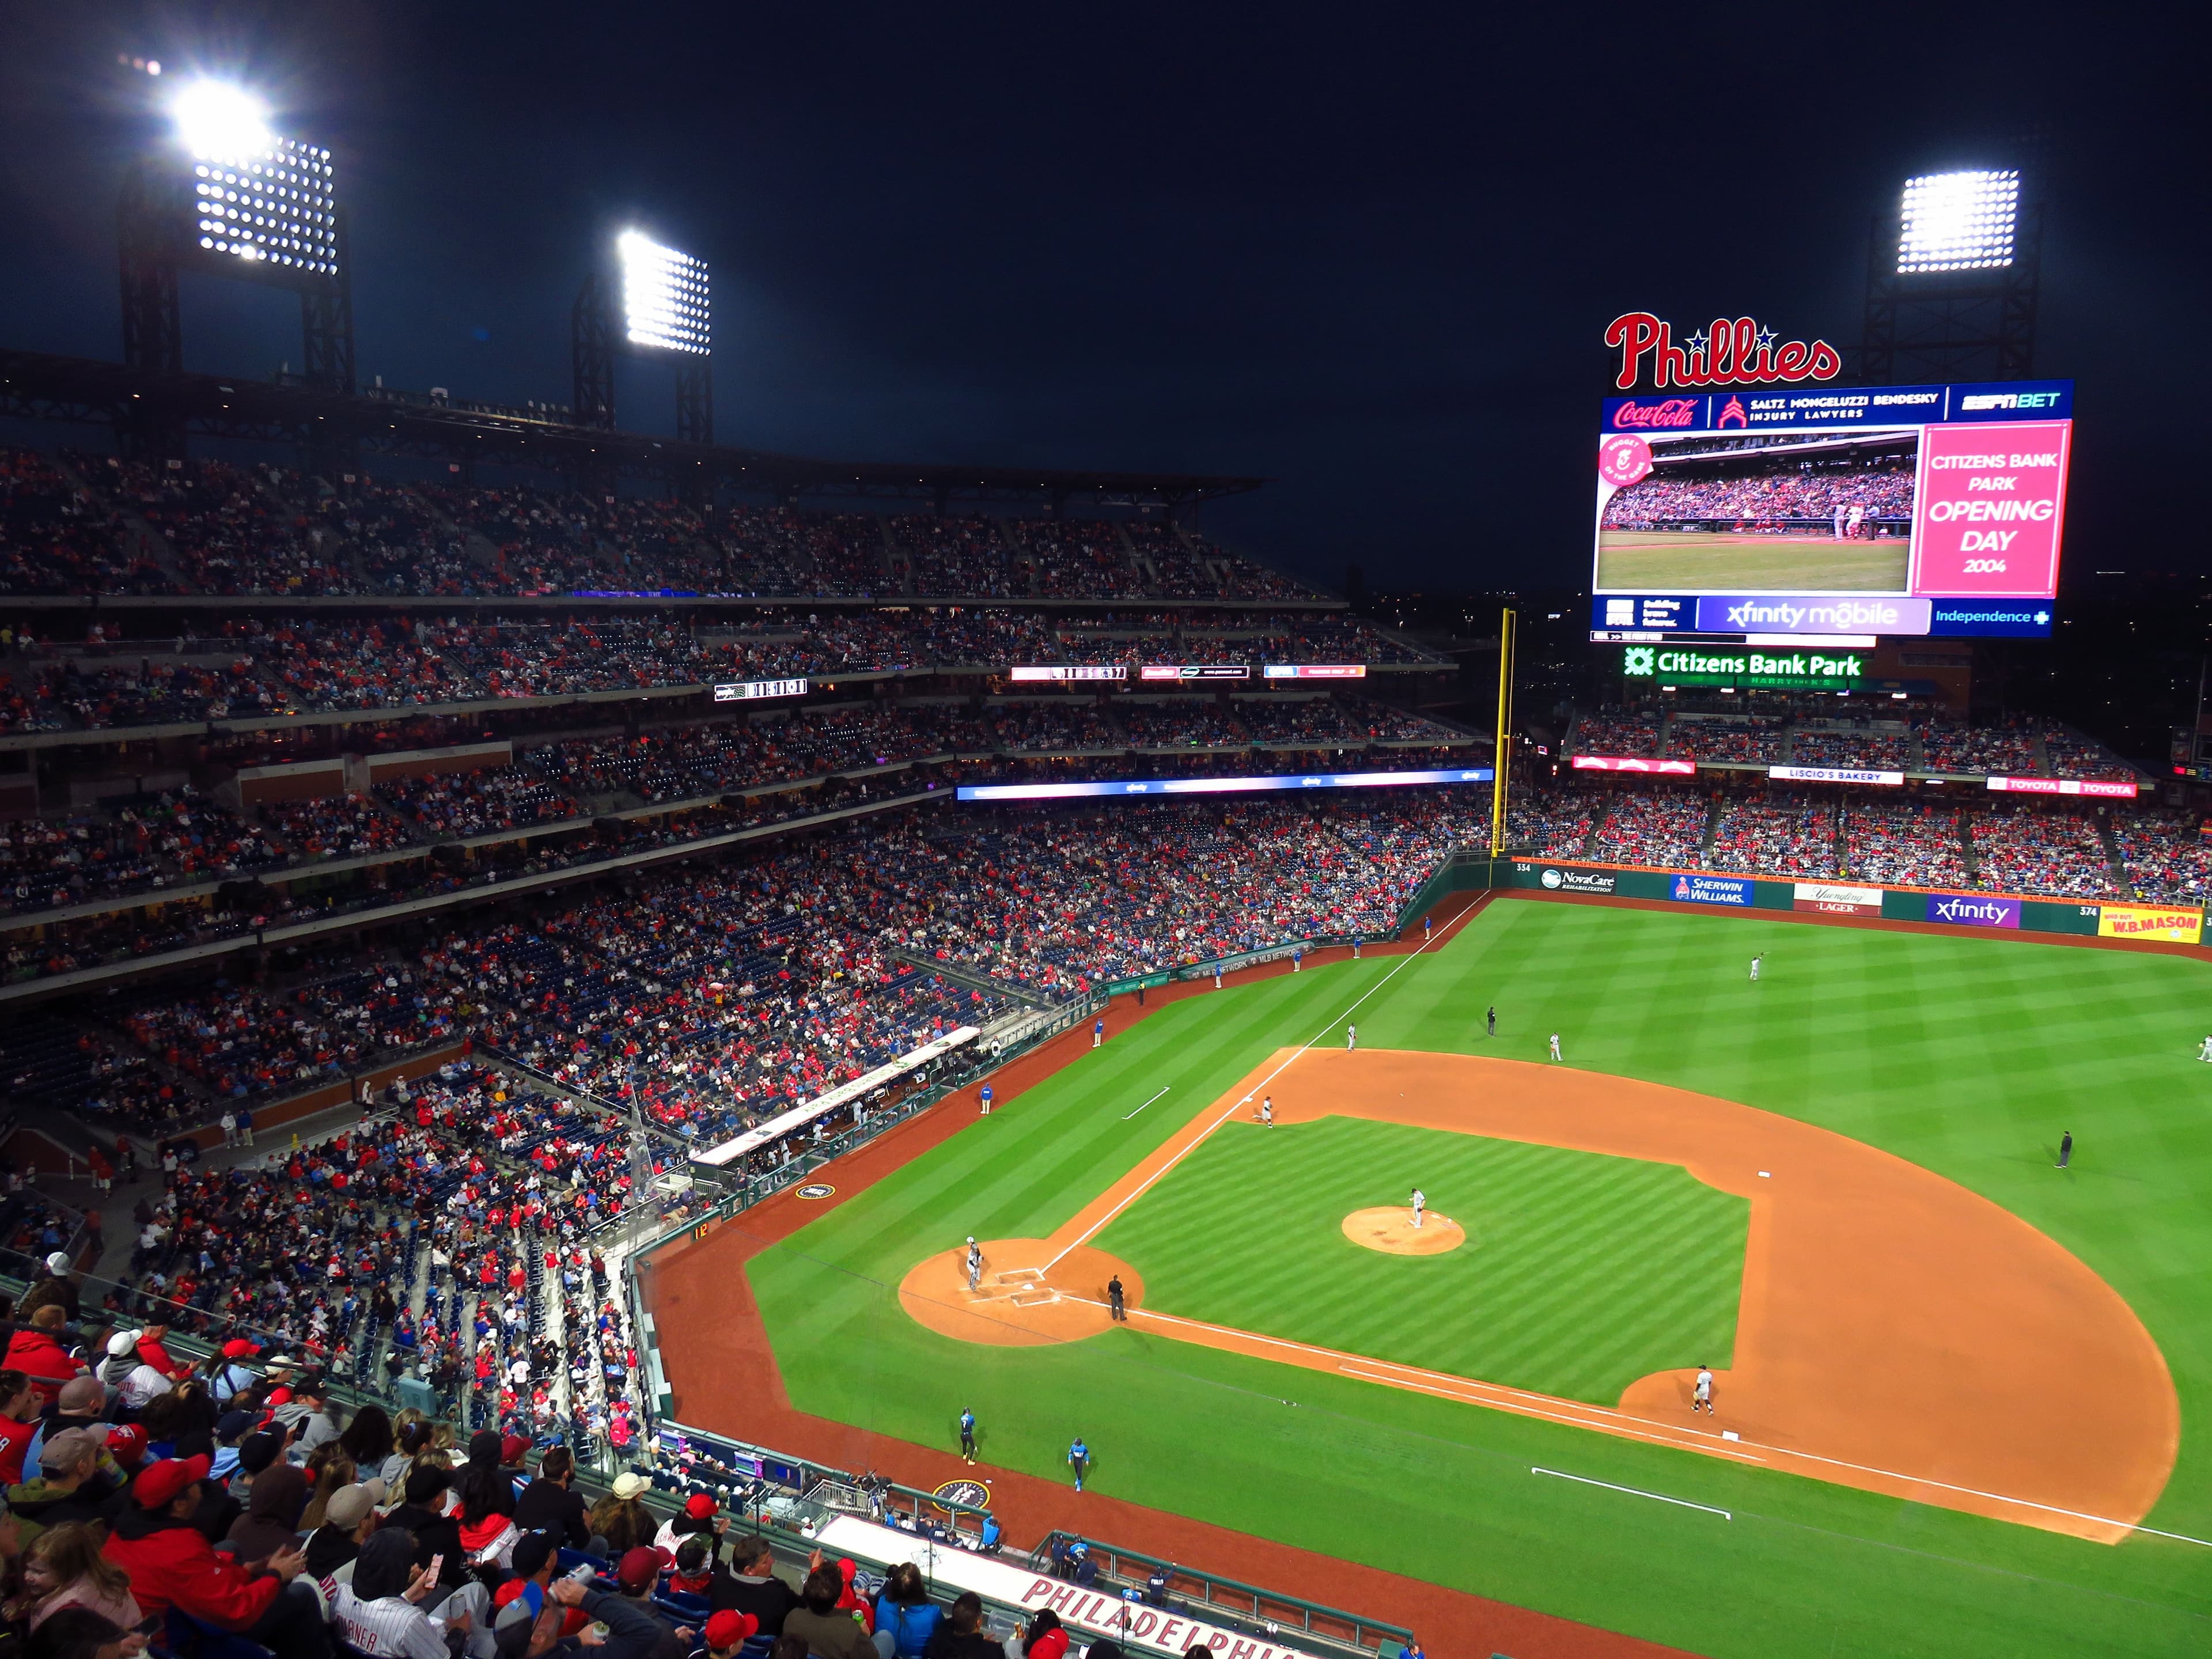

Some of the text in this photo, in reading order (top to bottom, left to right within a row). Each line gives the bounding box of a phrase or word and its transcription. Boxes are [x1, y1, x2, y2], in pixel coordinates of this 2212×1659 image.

[1604, 312, 1842, 389] Phillies
[1750, 392, 1939, 410] SALTZ MONGELUZZI BENDESKY
[1613, 399, 1698, 429] Coca-Cola
[1749, 409, 1863, 422] INJURY LAWYERS
[1608, 439, 1639, 451] NUGGET
[1930, 452, 2058, 470] CITIZENS BANK
[1605, 462, 1645, 480] OF THE GAME
[1968, 476, 2017, 491] PARK
[1929, 499, 2054, 522] OPENING
[1960, 530, 2018, 552] DAY
[1963, 559, 2006, 573] 2004
[1726, 601, 1898, 628] xfinity mobile
[1936, 609, 2032, 625] Independence
[1657, 653, 1861, 676] Citizens Bank Park
[1790, 769, 1881, 781] LISCIO'S BAKERY
[2009, 780, 2056, 791] TOYOTA
[2084, 783, 2131, 795] TOYOTA
[1516, 863, 1531, 872] 334
[1620, 865, 1660, 873] ASPLUNDH
[1562, 872, 1615, 887] NovaCare
[1715, 872, 1756, 880] ASPLUNDH
[1764, 876, 1806, 884] ASPLUNDH
[1562, 884, 1612, 893] REHABILITATION
[1692, 878, 1743, 892] SHERWIN
[1815, 879, 1858, 888] ASPLUNDH
[1866, 883, 1910, 891] ASPLUNDH
[1811, 887, 1866, 903] Yuengling
[1918, 887, 1964, 896] ASPLUNDH
[1972, 891, 2019, 899] ASPLUNDH
[2028, 895, 2074, 904] ASPLUNDH
[2085, 900, 2134, 908] ASPLUNDH
[1819, 902, 1854, 912] LAGER
[1936, 899, 2009, 924] xfinity
[2079, 906, 2097, 916] 374
[2146, 904, 2196, 912] ASPLUNDH
[1259, 947, 1300, 964] MLB NETWOR
[1219, 960, 1248, 974] ETWORK
[1021, 1579, 1294, 1659] PHILADELPH
[336, 1614, 377, 1652] TURNER
